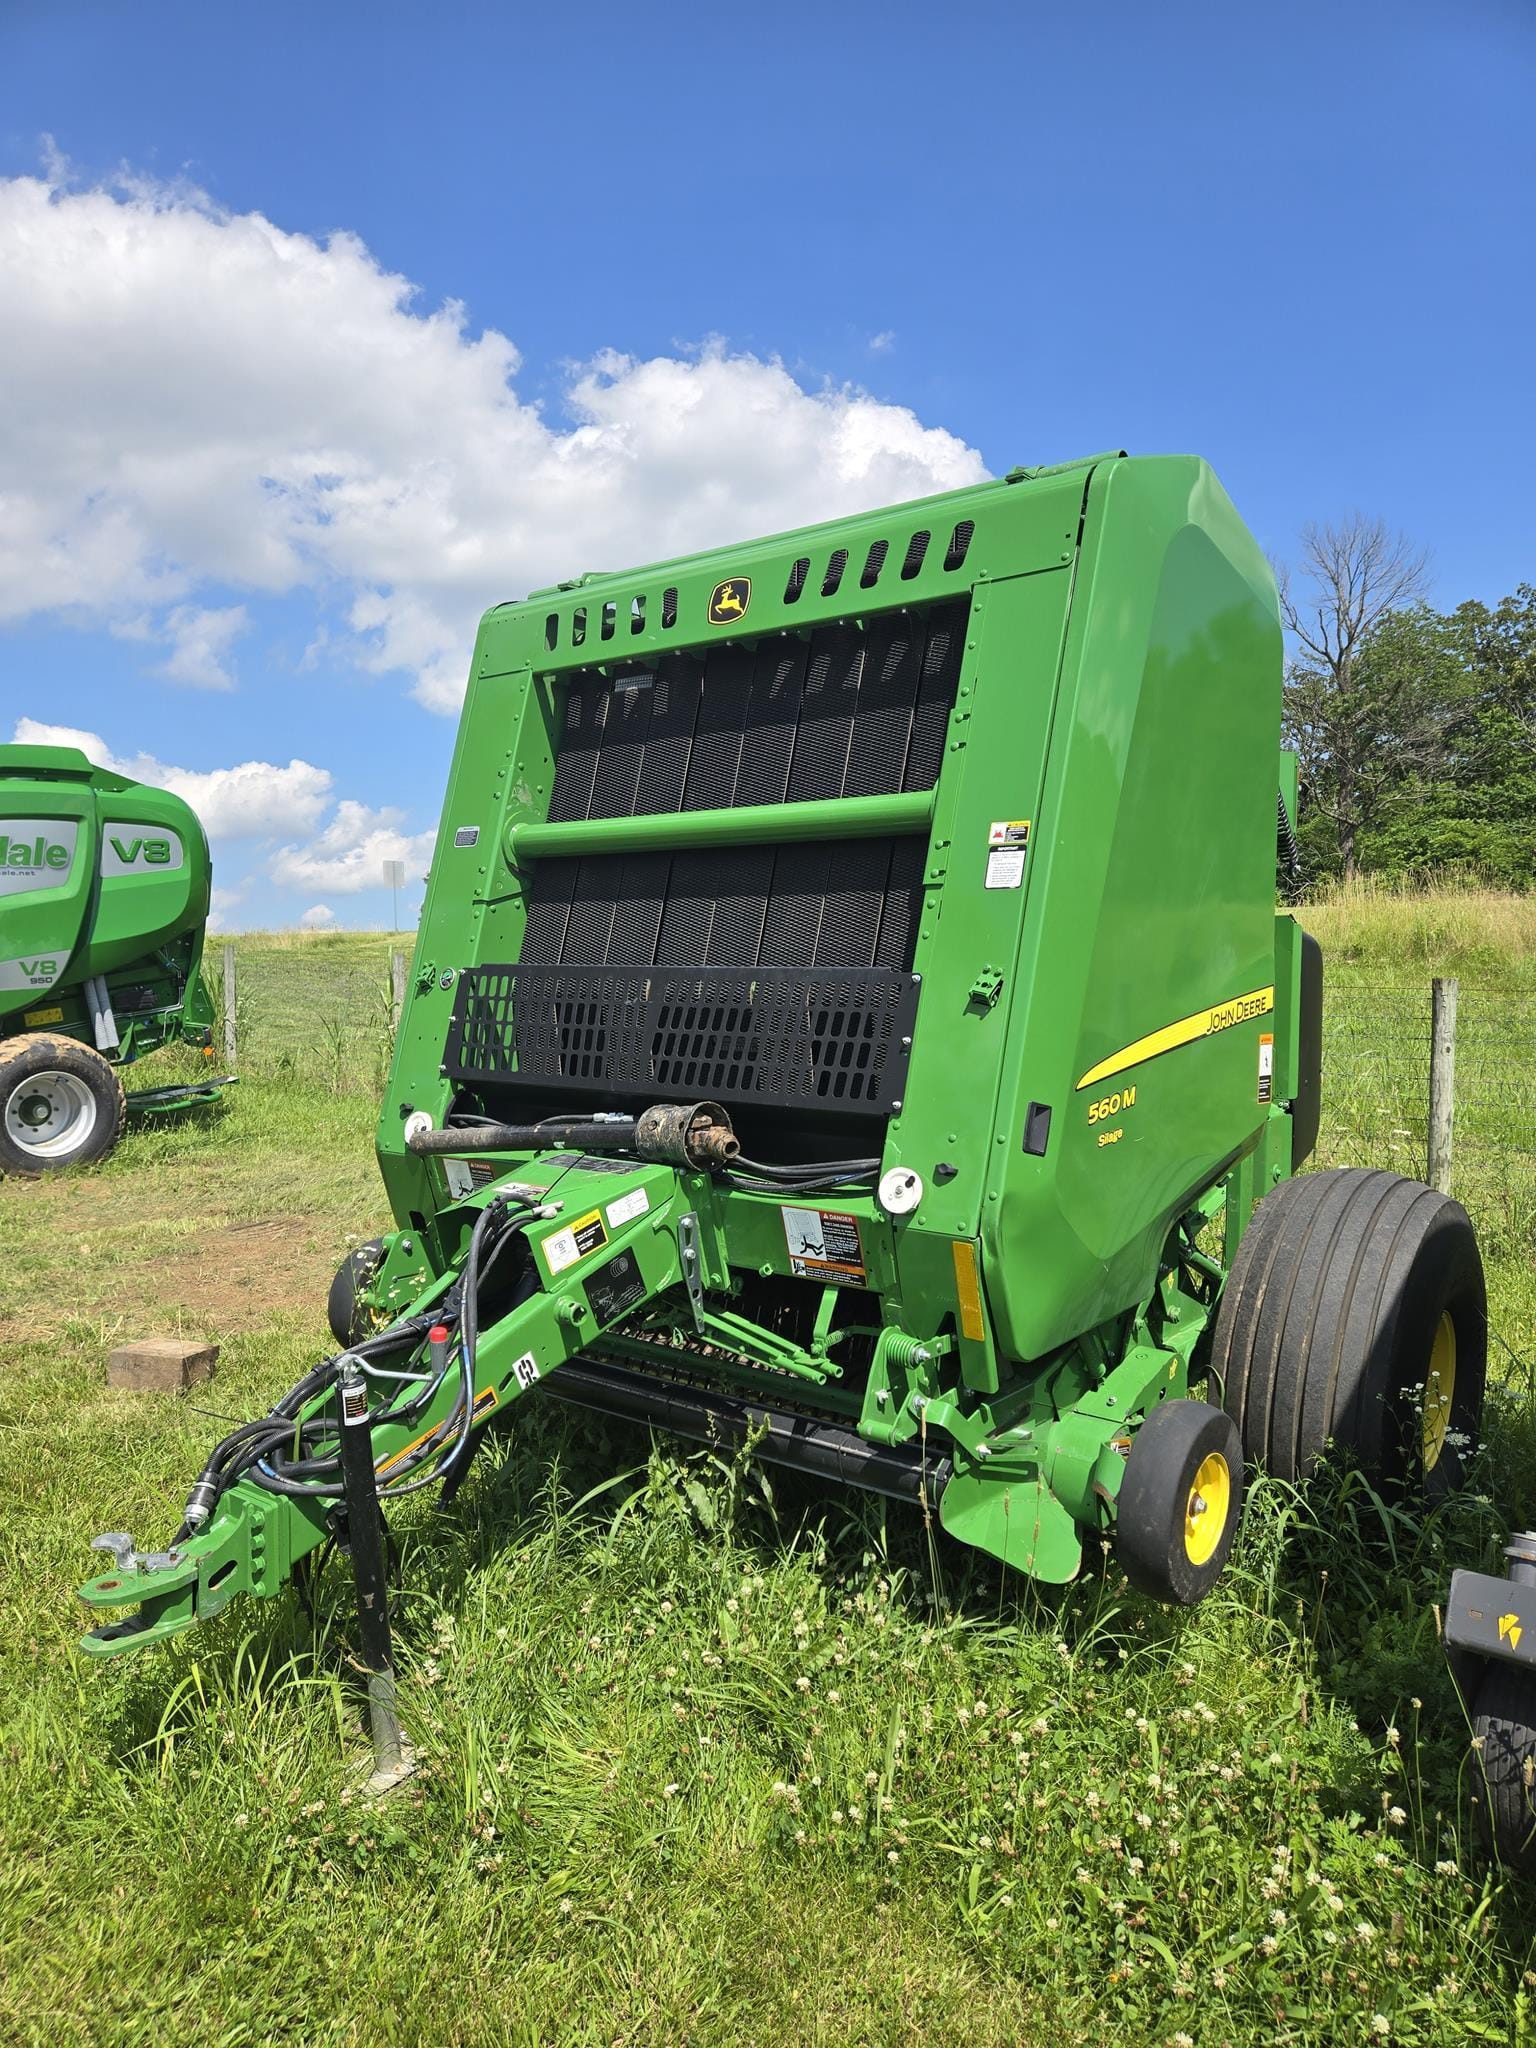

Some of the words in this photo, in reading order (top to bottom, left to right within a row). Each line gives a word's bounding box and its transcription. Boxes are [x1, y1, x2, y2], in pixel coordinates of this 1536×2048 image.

[110, 837, 171, 864] V8
[19, 960, 58, 977] V8
[30, 976, 53, 985] 950
[1206, 1007, 1235, 1032] JOHN
[1236, 996, 1267, 1020] DEERE
[1098, 1128, 1123, 1147] Silage
[829, 1213, 853, 1223] DANGER
